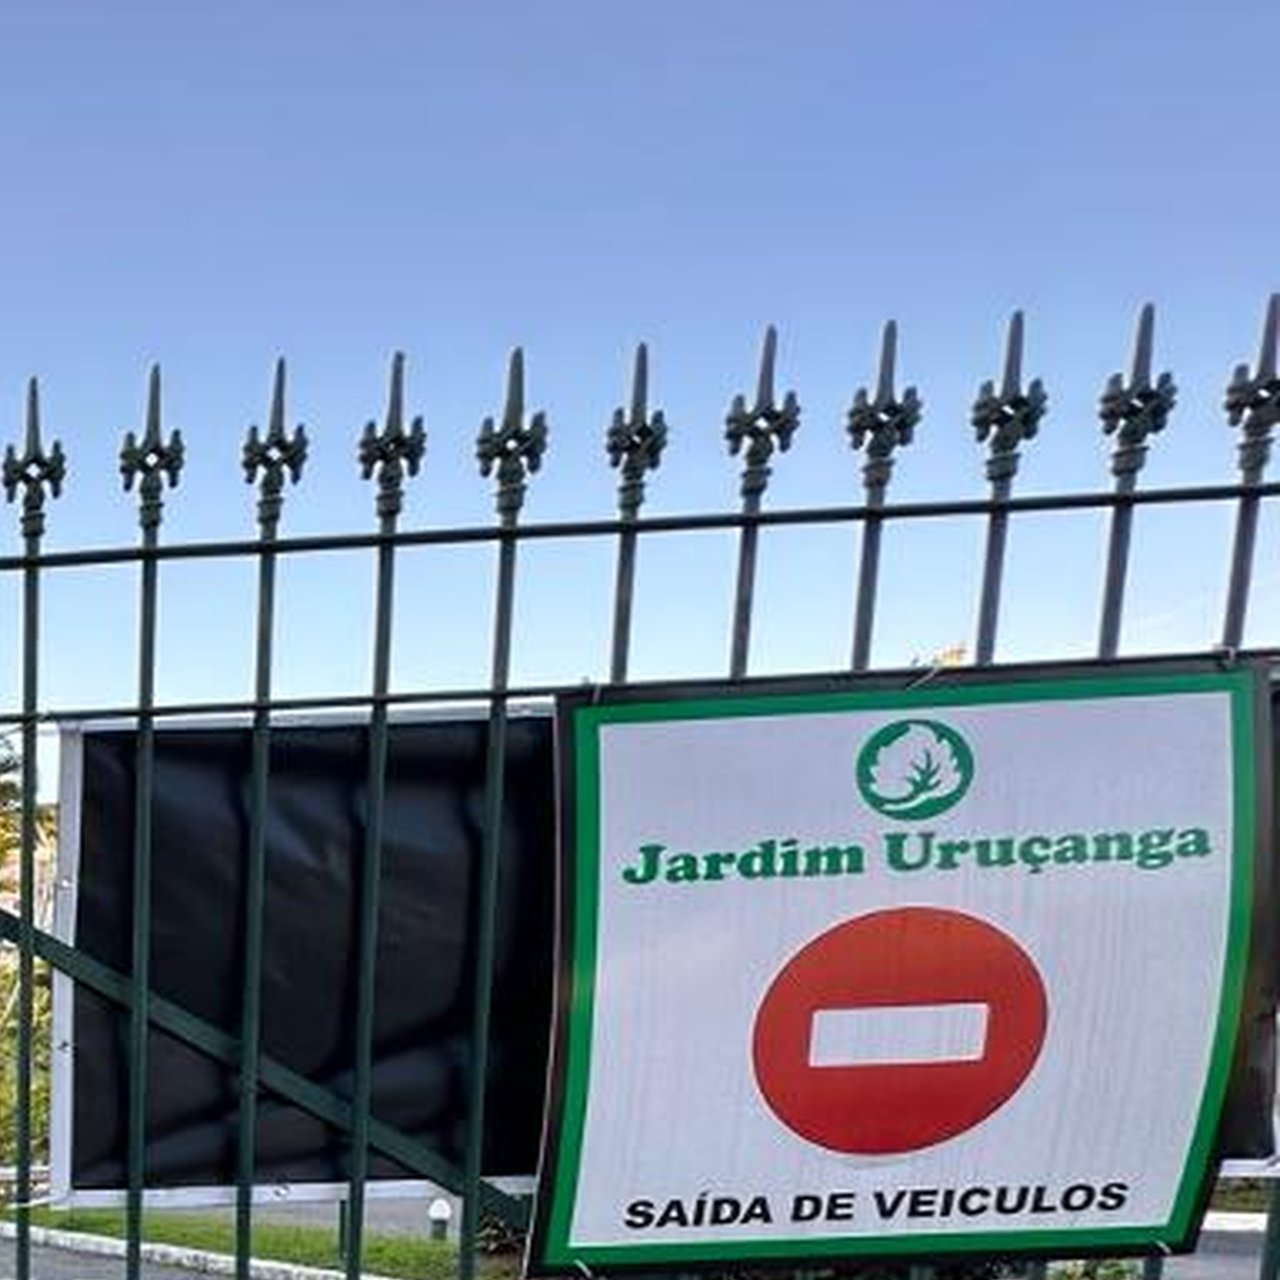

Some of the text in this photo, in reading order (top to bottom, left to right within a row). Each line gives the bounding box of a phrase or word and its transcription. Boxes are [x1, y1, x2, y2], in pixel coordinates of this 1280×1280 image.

[621, 826, 1214, 886] Jardim Uruçanga
[624, 1181, 1131, 1230] SAÍDA DE VEICULOS
